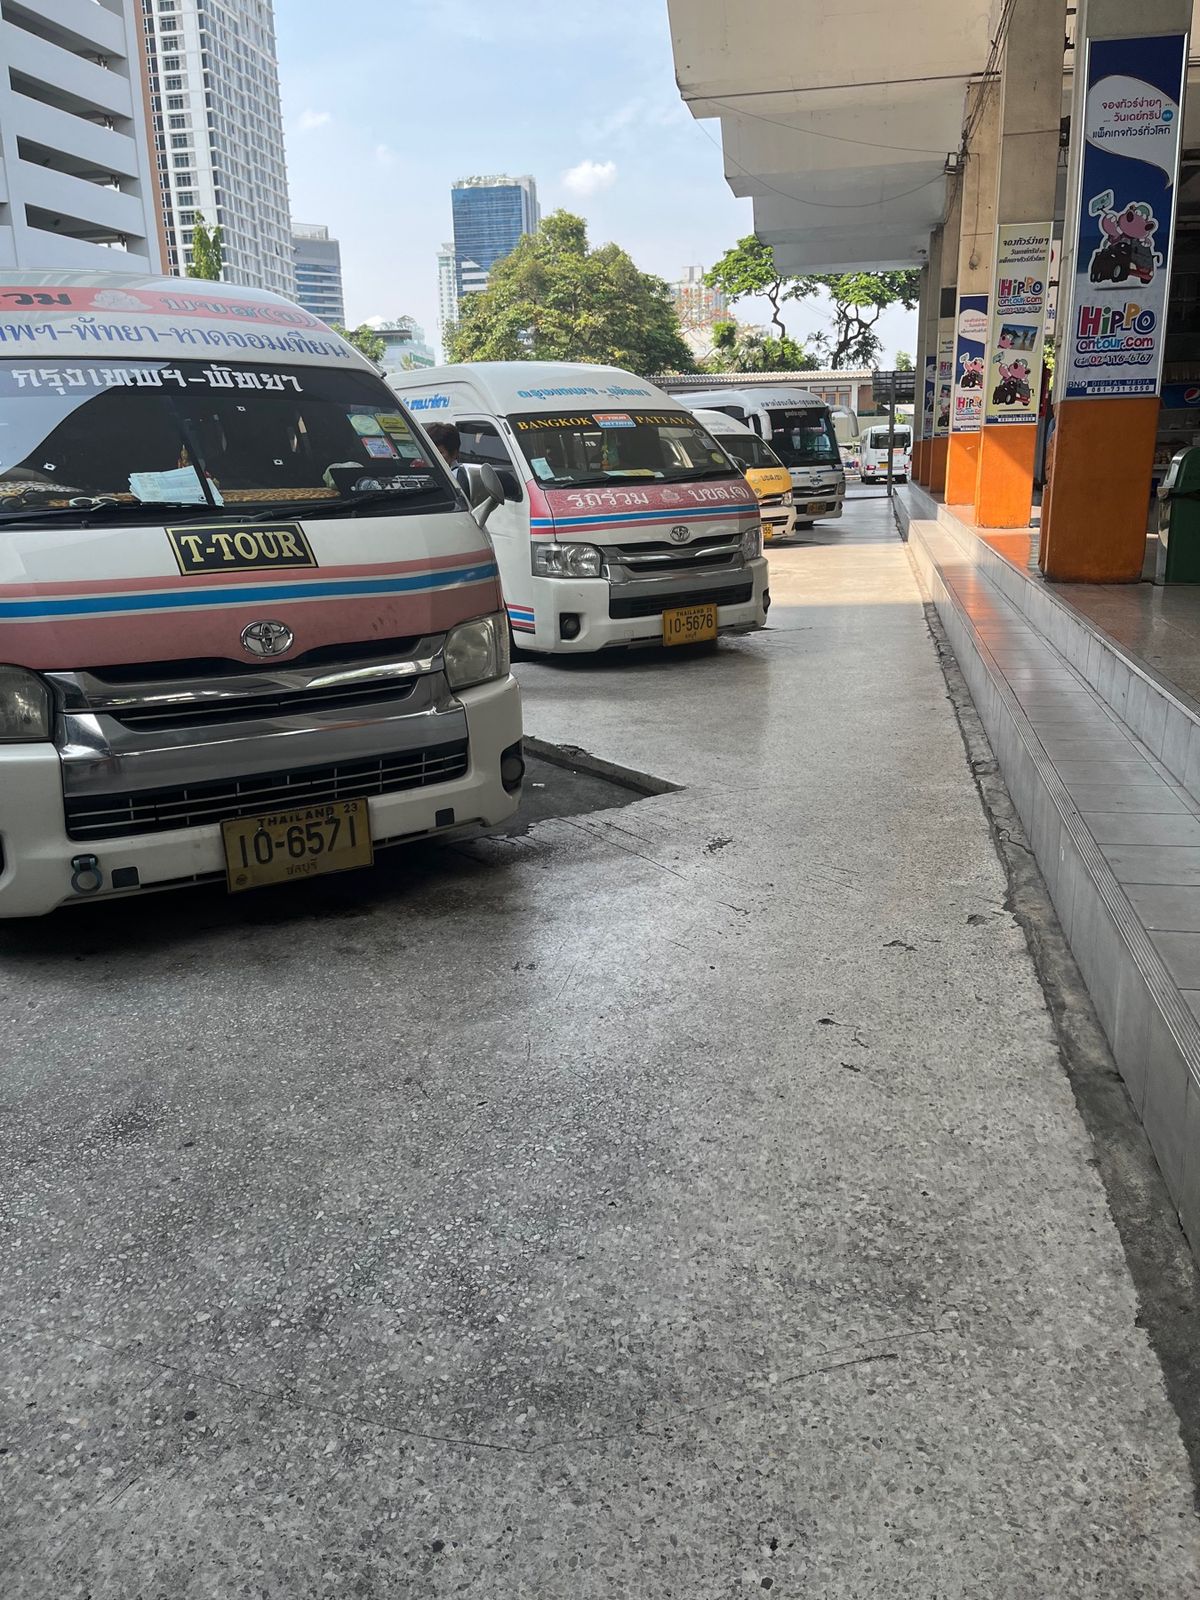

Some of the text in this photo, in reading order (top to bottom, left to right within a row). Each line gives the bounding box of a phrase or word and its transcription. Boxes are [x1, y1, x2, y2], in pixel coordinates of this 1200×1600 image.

[517, 415, 695, 430] BANGKOK PATTAYA
[567, 488, 650, 508] รถร่วม
[180, 531, 305, 562] T-TOUR
[669, 613, 713, 634] 10-5676
[257, 802, 358, 827] THAILAND 23
[239, 815, 357, 868] 10-6571
